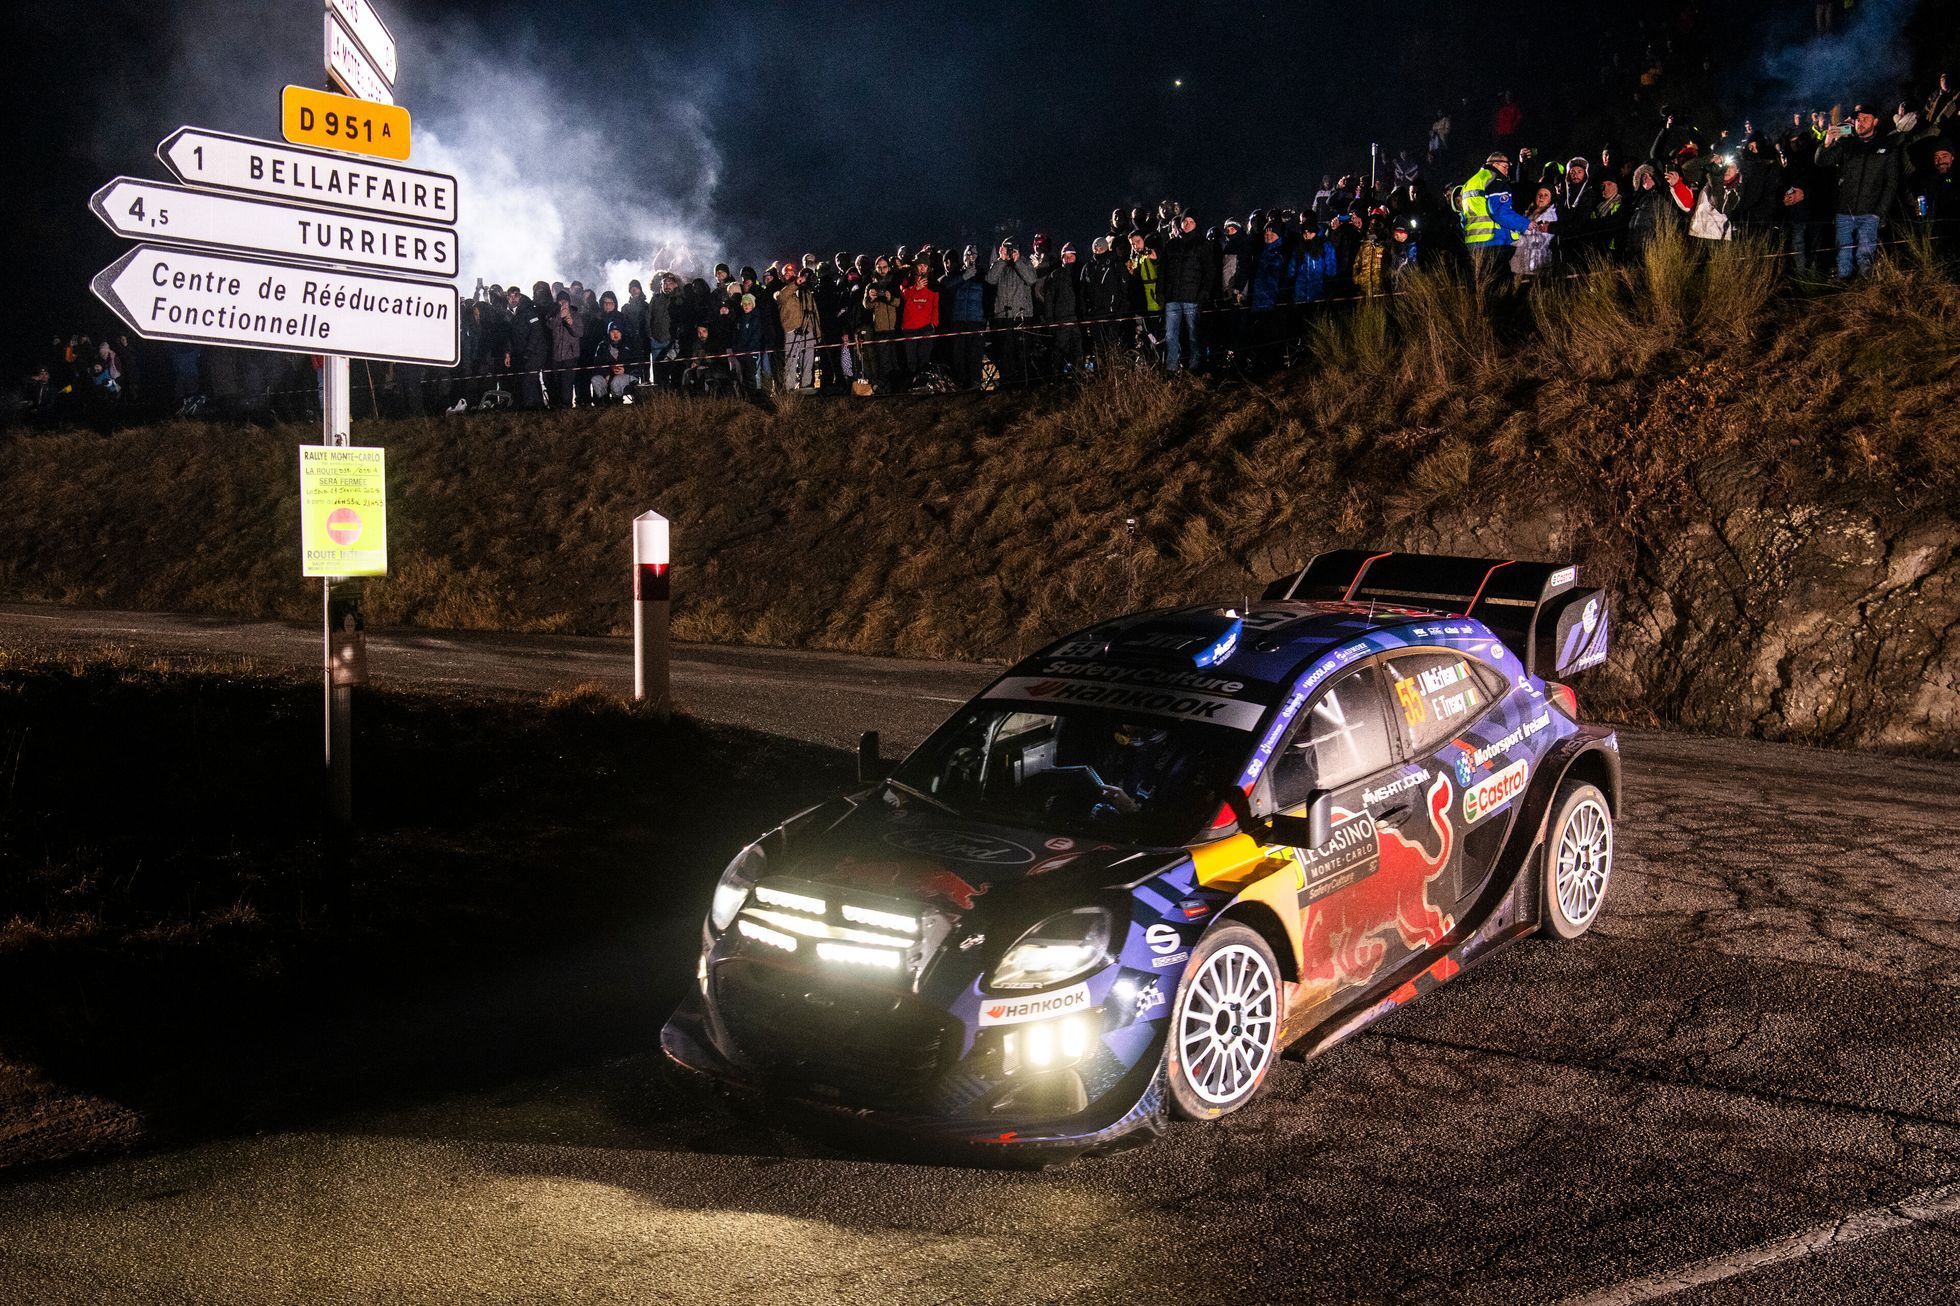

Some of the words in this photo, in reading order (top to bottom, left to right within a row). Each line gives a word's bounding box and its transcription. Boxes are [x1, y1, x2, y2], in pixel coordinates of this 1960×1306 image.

[193, 146, 203, 171] 1
[250, 155, 447, 211] BELLAFFAIRE
[128, 197, 169, 227] 4,5
[298, 220, 447, 263] TURRIERS
[152, 262, 240, 296] Centre
[258, 276, 286, 301] de
[302, 279, 448, 320] Rééducation
[152, 297, 331, 339] Fonctionnelle
[304, 451, 327, 461] RALLYE
[330, 452, 380, 462] MONTE-CARLO
[307, 550, 336, 559] ROUTE
[1043, 660, 1244, 694] SafetyCulture
[1303, 660, 1337, 687] WOODLAND
[1417, 674, 1427, 697] J
[1395, 677, 1425, 726] 55
[1432, 698, 1444, 720] E
[1473, 727, 1523, 767] Motorsport
[1523, 709, 1551, 738] Ireland
[1479, 764, 1525, 811] Castrol
[1309, 872, 1355, 899] SafetyCulture
